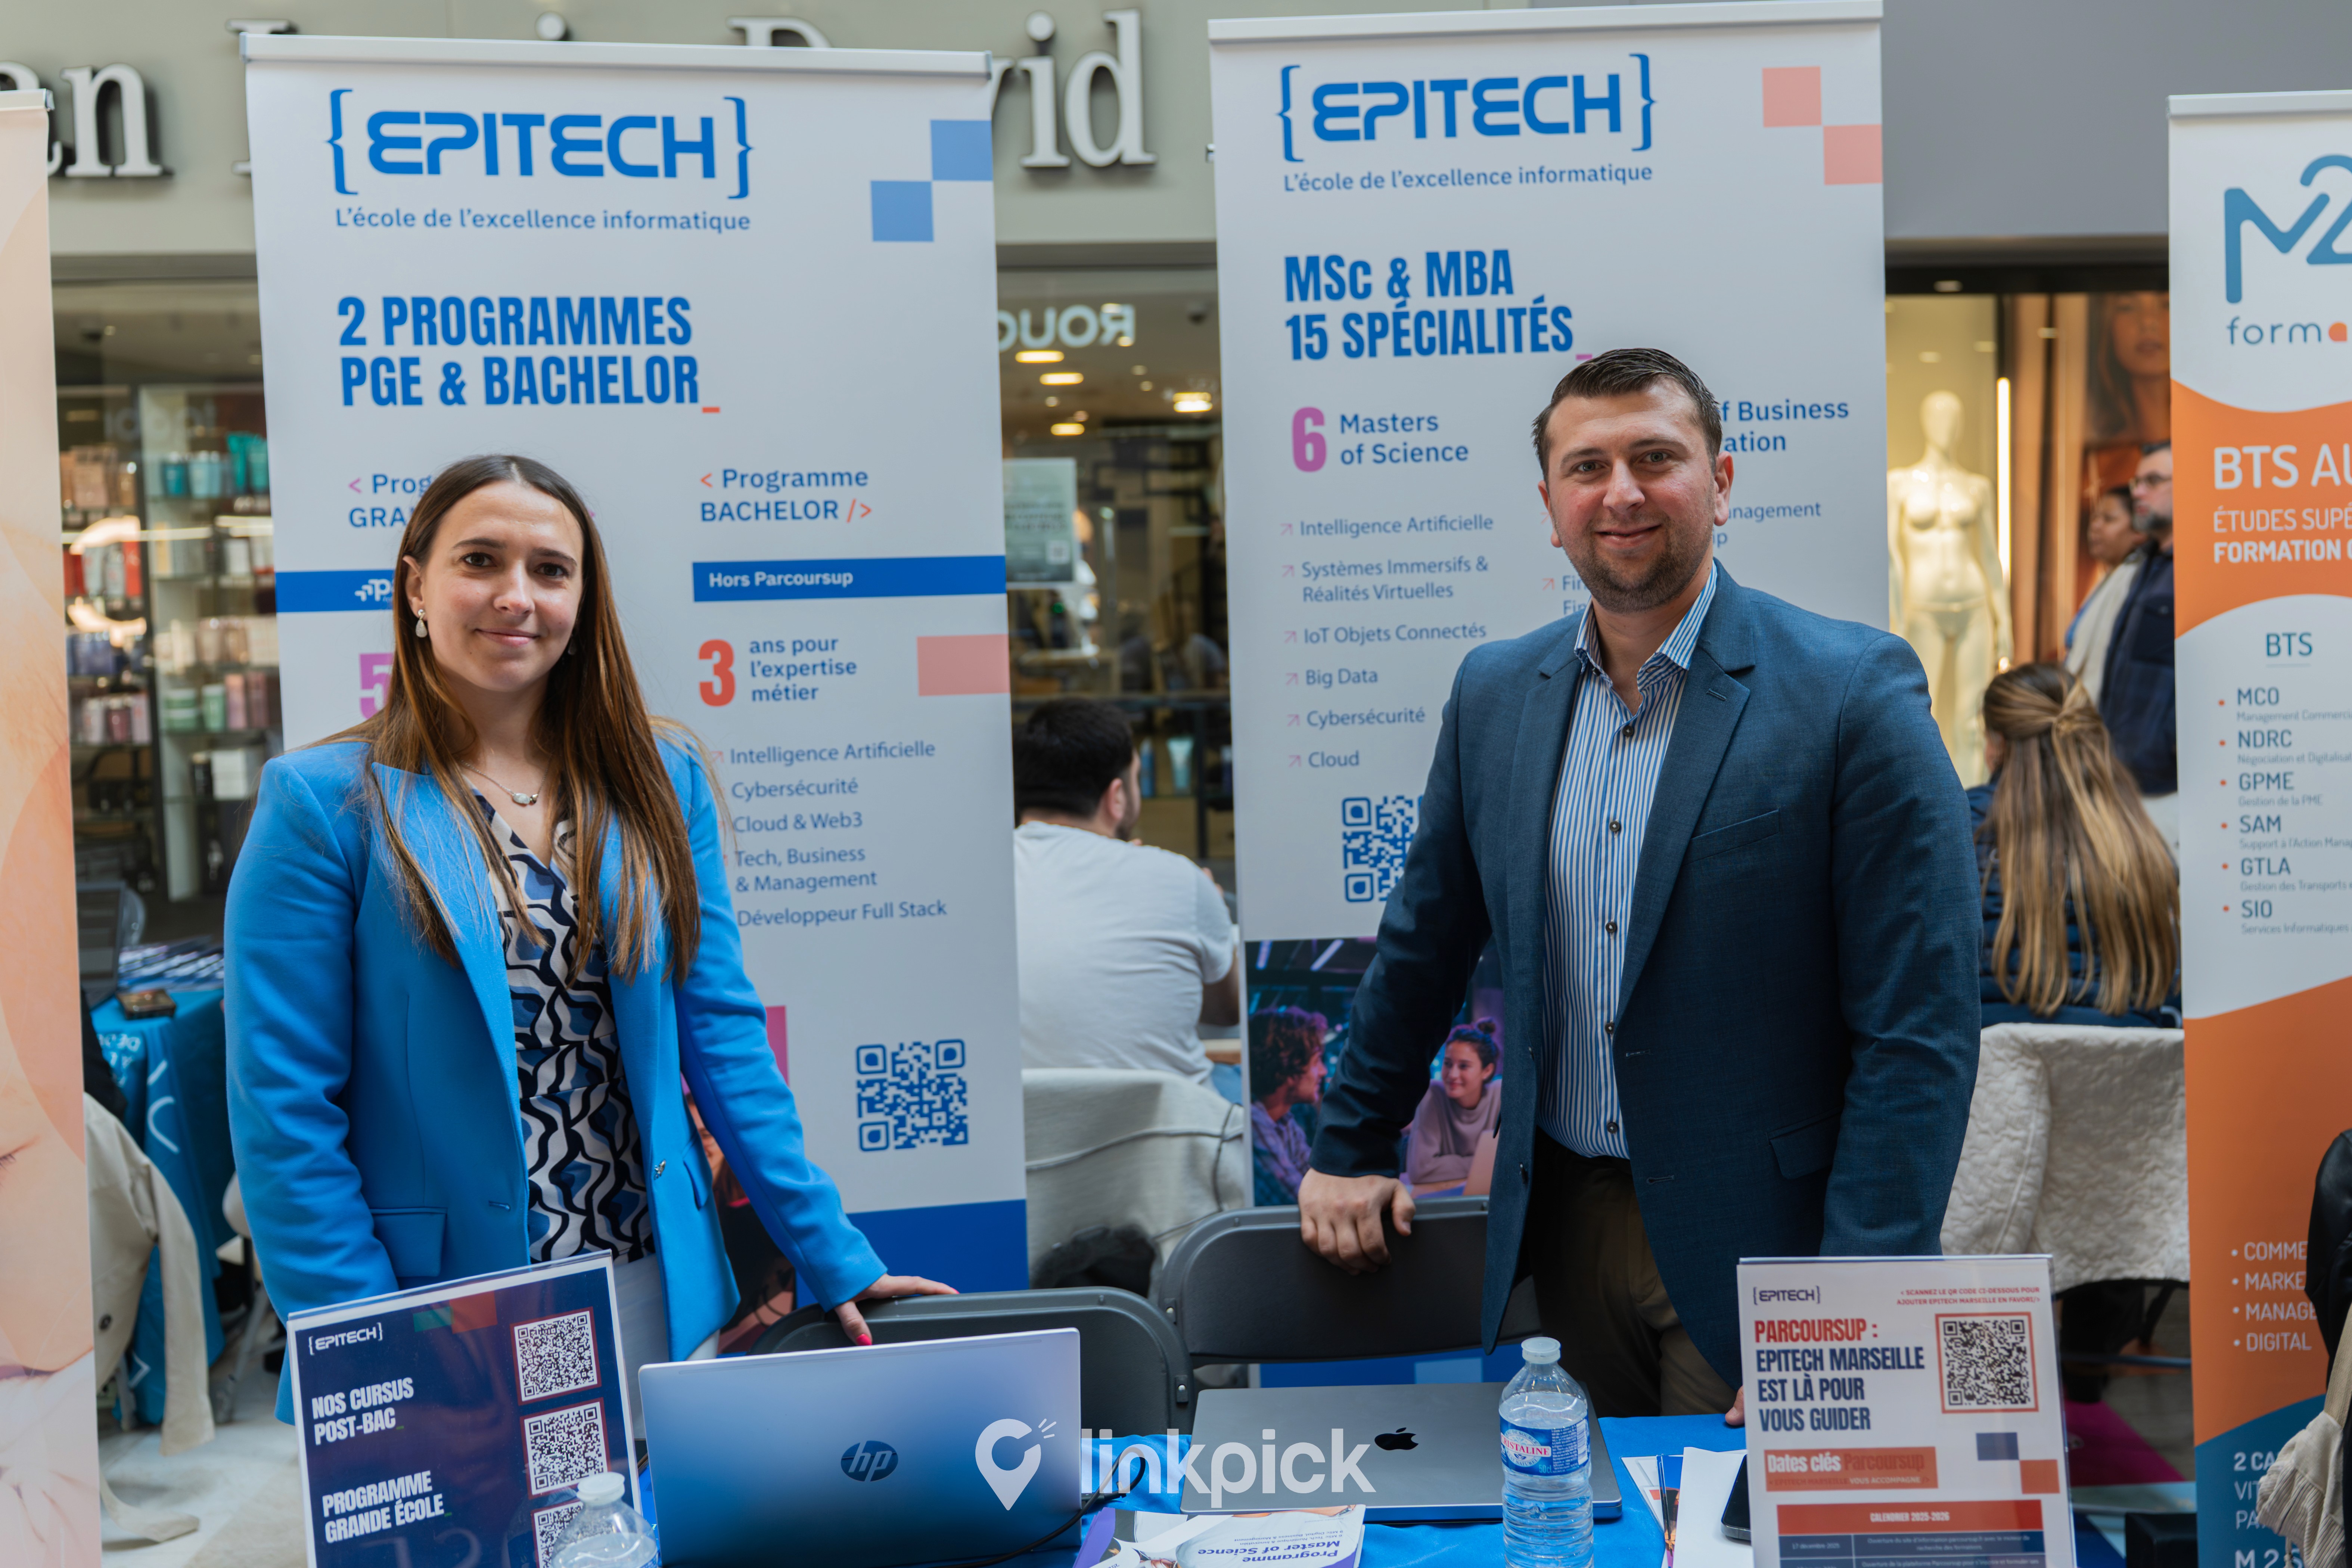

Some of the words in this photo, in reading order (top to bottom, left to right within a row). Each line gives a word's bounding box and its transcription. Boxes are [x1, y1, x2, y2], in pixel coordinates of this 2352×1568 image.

[1360, 172, 1385, 189] de
[1392, 169, 1512, 187] l'excellence
[1519, 164, 1652, 184] informatique
[424, 209, 451, 227] de
[460, 209, 596, 229] l'excellence
[604, 210, 750, 234] informatique
[1285, 255, 1372, 302] MSc
[1387, 257, 1411, 299] &
[1426, 249, 1514, 297] MBA
[338, 296, 366, 346] 2
[382, 296, 692, 346] PROGRAMMES
[1286, 314, 1328, 360] 15
[341, 357, 423, 406] PGE
[439, 362, 466, 406] &
[1739, 399, 1848, 421] Business
[1340, 414, 1438, 434] Masters
[1292, 407, 1327, 472] 6
[1341, 444, 1364, 465] of
[1373, 442, 1468, 464] Science
[2214, 445, 2299, 489] BTS
[723, 469, 868, 493] Programme
[701, 500, 838, 521] BACHELOR
[2214, 506, 2297, 533] ÉTUDES
[1301, 519, 1402, 538] Intelligence
[1407, 515, 1493, 531] Artificielle
[2214, 539, 2341, 563] FORMATION
[709, 573, 750, 587] Hors
[754, 571, 853, 587] Parcoursup
[1302, 561, 1383, 581] Systèmes
[1388, 556, 1471, 574] Immersifs
[1476, 556, 1488, 571] &
[1303, 586, 1369, 602] Réalités
[1373, 583, 1453, 599] Virtuelles
[1334, 627, 1391, 646] Objets
[1395, 622, 1486, 641] Connectés
[2266, 633, 2312, 656] BTS
[750, 640, 785, 653] ans
[792, 639, 838, 656] pour
[699, 639, 735, 707] 3
[751, 659, 857, 680] l'expertise
[1306, 670, 1333, 689] Big
[1338, 668, 1378, 684] Data
[752, 684, 818, 701] métier
[2237, 687, 2279, 705] MCO
[1307, 707, 1425, 730] Cybersécurité
[2236, 710, 2300, 724] Management
[2238, 730, 2292, 748] NDRC
[731, 746, 839, 767] Intelligence
[844, 740, 935, 759] Artificielle
[1308, 750, 1360, 768] Cloud
[731, 778, 858, 802] Cybersécurité
[2239, 772, 2293, 791] GPME
[2238, 796, 2275, 808] Gestion
[2277, 795, 2289, 806] de
[2291, 795, 2300, 805] la
[2301, 794, 2323, 805] PME
[733, 815, 788, 833] Cloud
[792, 813, 807, 830] &
[810, 812, 862, 829] Web3
[2240, 815, 2281, 833] SAM
[787, 847, 865, 864] Business
[2241, 857, 2290, 875] GTLA
[735, 875, 750, 894] &
[755, 872, 877, 893] Management
[2240, 881, 2277, 893] Gestion
[2279, 880, 2296, 892] des
[736, 904, 858, 928] Développeur
[863, 902, 894, 919] Full
[899, 900, 947, 917] Stack
[2242, 900, 2272, 918] SIO
[1755, 1319, 1866, 1343] PARCOURSUP
[2246, 1332, 2312, 1352] DIGITAL
[1756, 1349, 1824, 1372] EPITECH
[1829, 1347, 1924, 1370] MARSEILLE
[311, 1393, 346, 1419] NOS
[350, 1378, 414, 1410] CURSUS
[1758, 1379, 1787, 1401] EST
[1793, 1373, 1814, 1401] LÀ
[1819, 1378, 1864, 1401] POUR
[314, 1407, 396, 1445] POST-BAC
[1759, 1408, 1804, 1431] VOUS
[1810, 1407, 1870, 1431] GUIDER
[1501, 1435, 1550, 1456] CRISTALINE
[848, 1440, 893, 1482] hp
[1767, 1453, 1808, 1473] Dates
[1810, 1451, 1841, 1472] clés
[1843, 1453, 1925, 1472] Parcoursup
[322, 1470, 432, 1518] PROGRAMME
[324, 1506, 392, 1544] GRANDE
[394, 1493, 444, 1527] ÉCOLE
[1870, 1511, 1910, 1523] CALENDRIER
[1197, 1547, 1258, 1557] Science
[1242, 1550, 1338, 1563] Programme
[1283, 1540, 1341, 1550] Master
